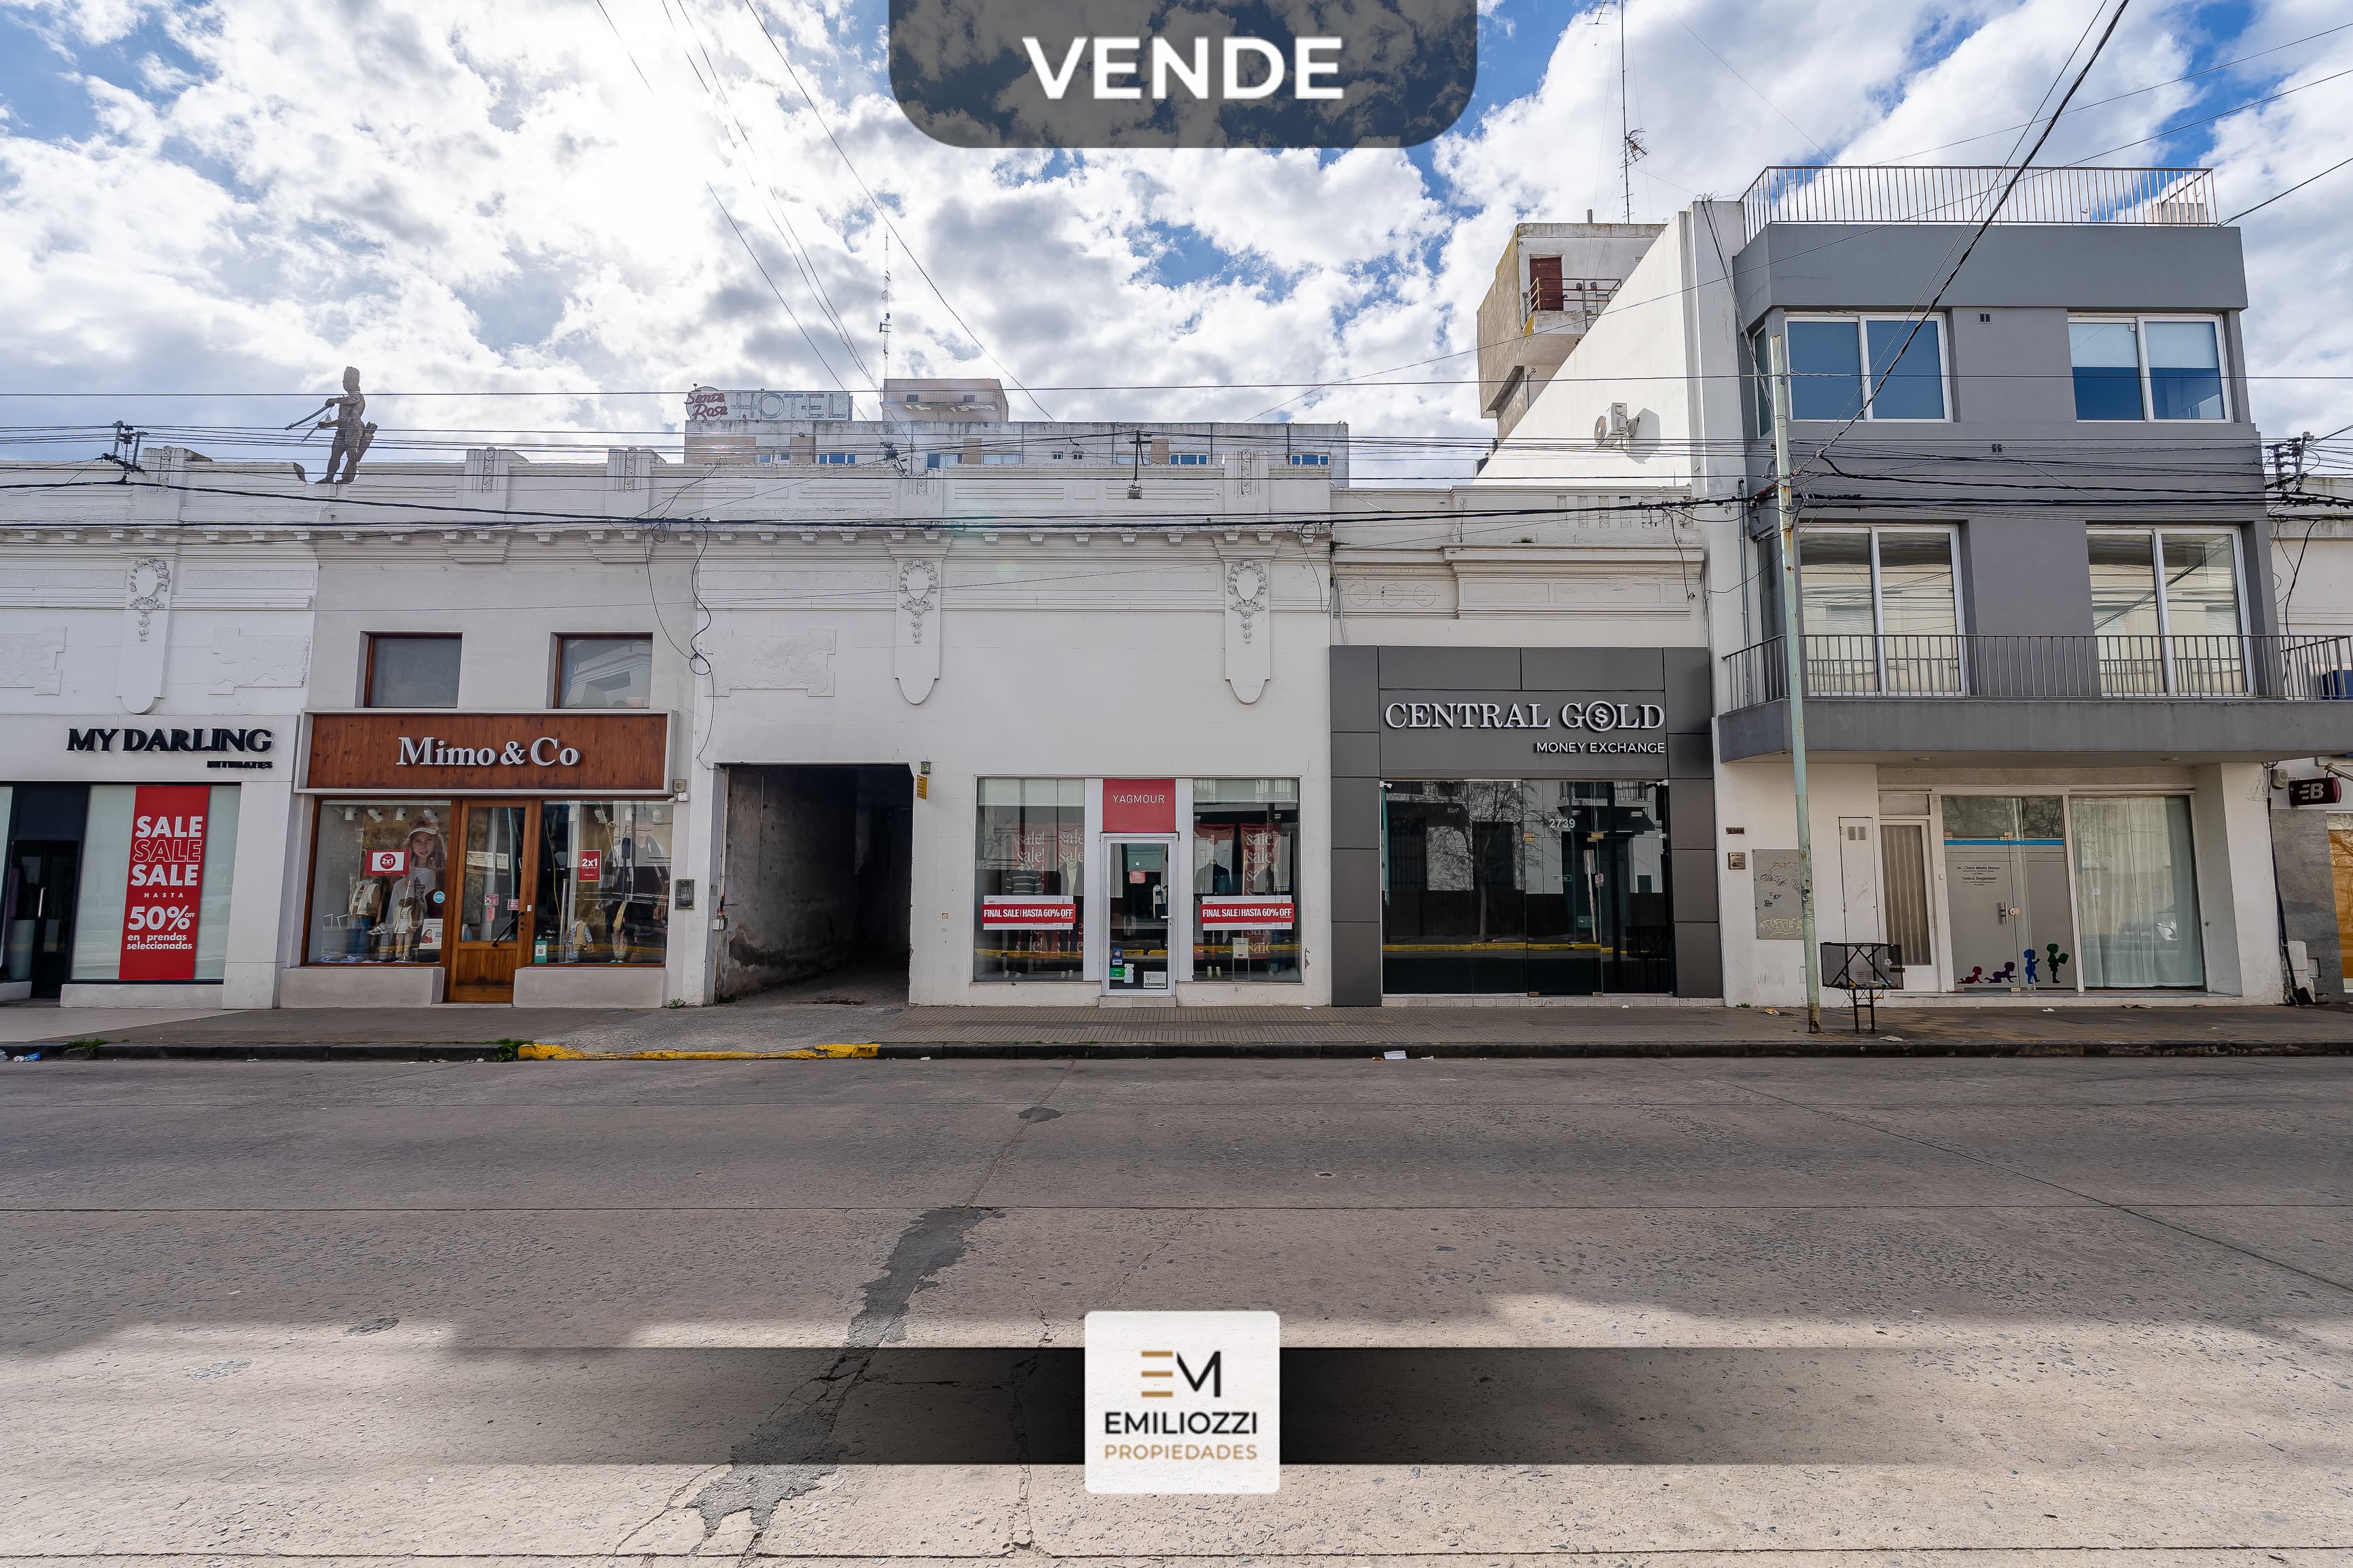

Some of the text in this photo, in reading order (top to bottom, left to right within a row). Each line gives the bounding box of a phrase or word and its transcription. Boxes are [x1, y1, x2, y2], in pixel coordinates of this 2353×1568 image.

[686, 393, 725, 405] Santa
[731, 393, 847, 419] HOTEL
[692, 403, 728, 421] Rosa
[1384, 702, 1551, 729] CENTRAL
[67, 728, 273, 753] MY DARLING
[1536, 742, 1666, 754] MONEY EXCHANGE
[1113, 794, 1165, 804] YAGMOUR
[135, 816, 204, 838] SALE
[1549, 818, 1576, 828] 2739
[1018, 831, 1045, 845] sale!
[1246, 829, 1275, 846] sale!
[132, 839, 202, 862] SALE
[1016, 847, 1045, 863] sale!
[581, 858, 598, 867] 2x1
[130, 864, 199, 886] SALE
[128, 905, 190, 932] 50%
[984, 909, 1074, 917] FINAL SALE HASTA 60% OFF
[1202, 908, 1292, 917] FINAL SALE HASTA 60% OFF
[147, 932, 187, 943] prendas
[126, 941, 193, 950] seleccionadas
